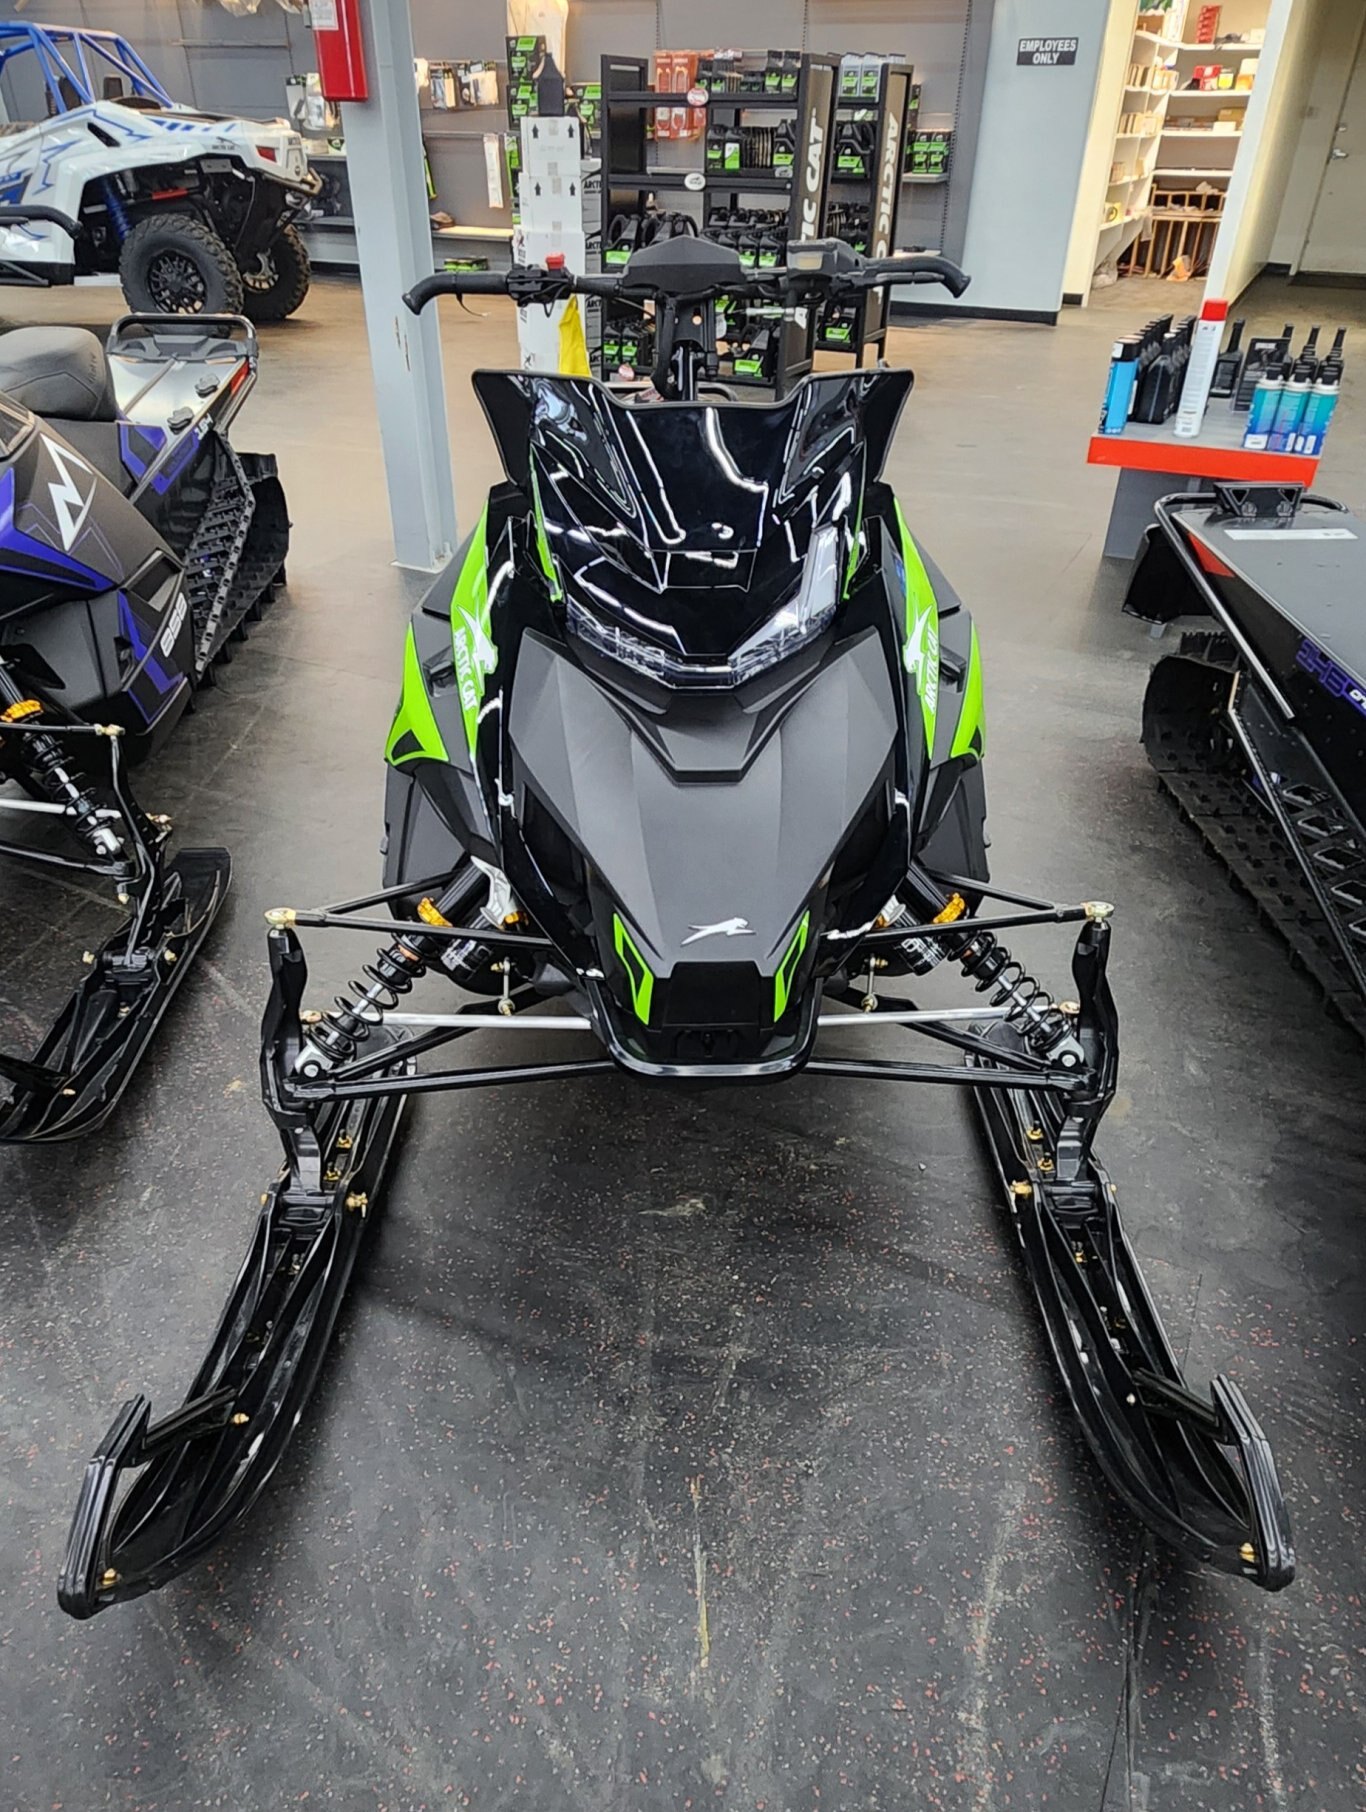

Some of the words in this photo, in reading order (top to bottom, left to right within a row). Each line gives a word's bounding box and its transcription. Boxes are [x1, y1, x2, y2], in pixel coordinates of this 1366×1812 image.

[1020, 39, 1077, 52] EMPLOYEES
[1032, 52, 1060, 64] ONLY
[805, 114, 824, 192] CAT
[878, 112, 900, 232] ARCTIC
[160, 592, 188, 656] 858
[454, 627, 472, 681] ARCTIC
[462, 680, 479, 711] CAT
